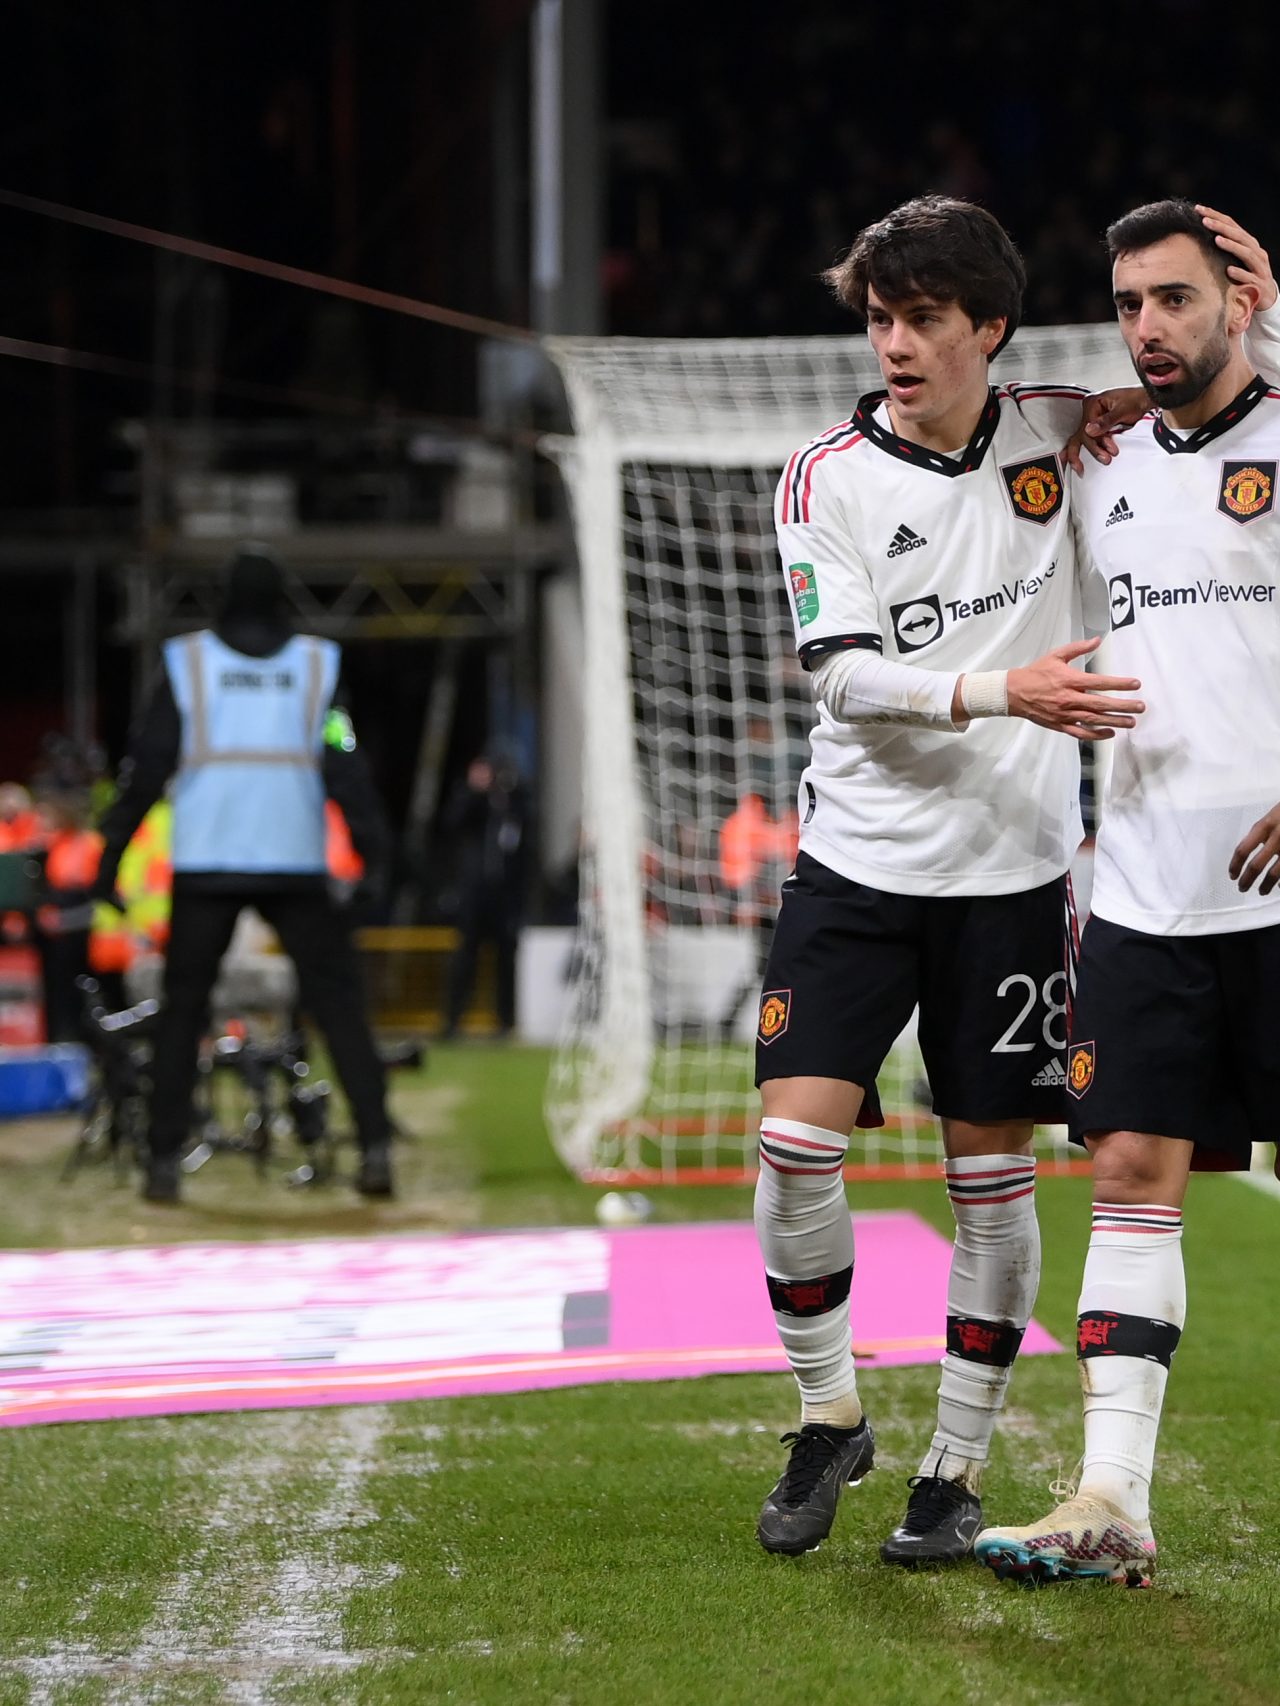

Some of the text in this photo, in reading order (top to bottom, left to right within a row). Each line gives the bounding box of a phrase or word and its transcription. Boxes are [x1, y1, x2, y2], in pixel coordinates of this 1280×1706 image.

[1231, 502, 1259, 511] UNITED
[1105, 511, 1134, 527] adidas
[886, 537, 928, 559] adidas
[1135, 579, 1276, 608] TeamViewer
[990, 970, 1067, 1053] 28
[1031, 1075, 1067, 1086] adida
